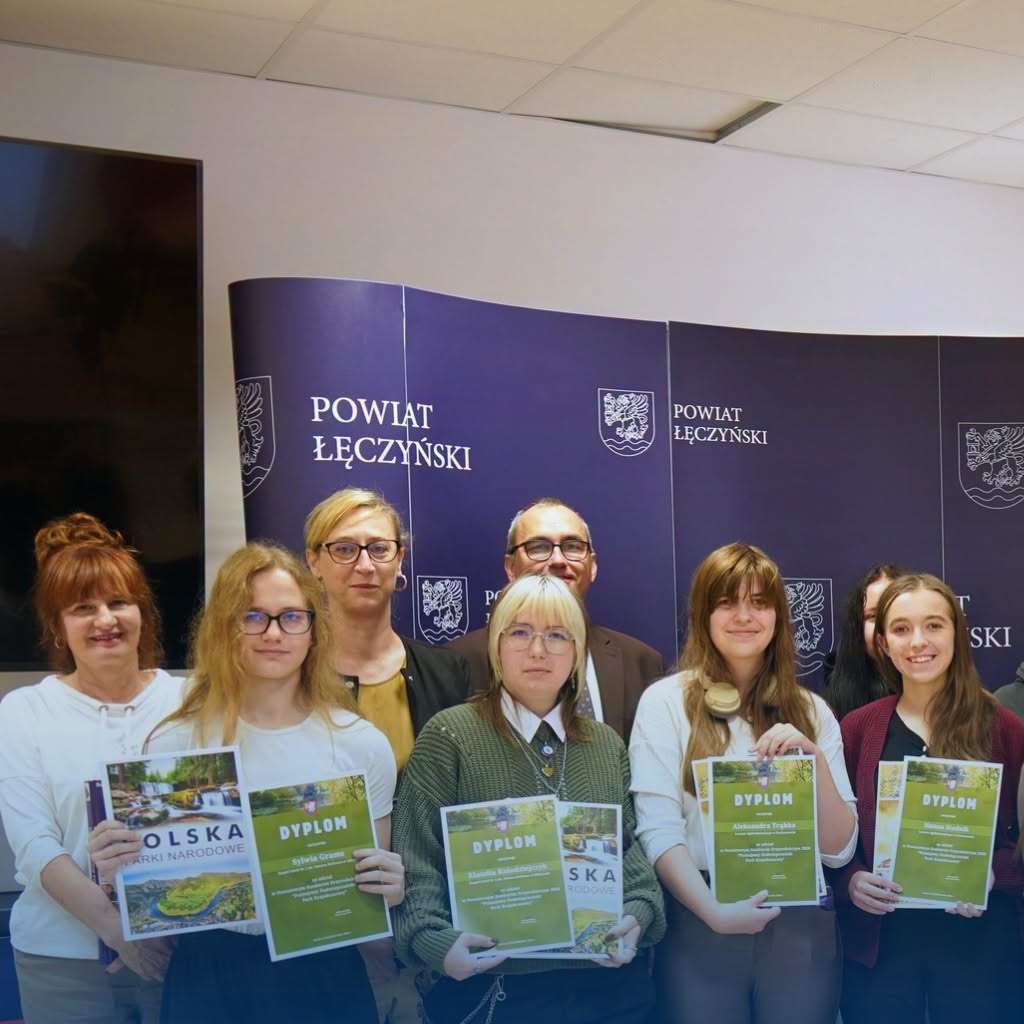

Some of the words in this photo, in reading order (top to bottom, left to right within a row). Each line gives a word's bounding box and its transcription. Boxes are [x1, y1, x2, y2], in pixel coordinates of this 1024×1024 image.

[311, 396, 433, 430] POWIAT
[673, 403, 743, 423] POWIAT
[673, 424, 768, 445] ŁĘCZYŃSKI
[313, 434, 472, 471] ŁĘCZYŃSKI
[734, 793, 793, 807] DYPLOM
[923, 794, 977, 810] DYPLOM
[143, 823, 245, 849] OLSKA
[279, 815, 348, 840] DYPLOM
[131, 853, 164, 866] ARKI
[168, 843, 245, 861] NARODOWE
[473, 834, 537, 854] DYPLOM
[569, 867, 617, 882] SKA
